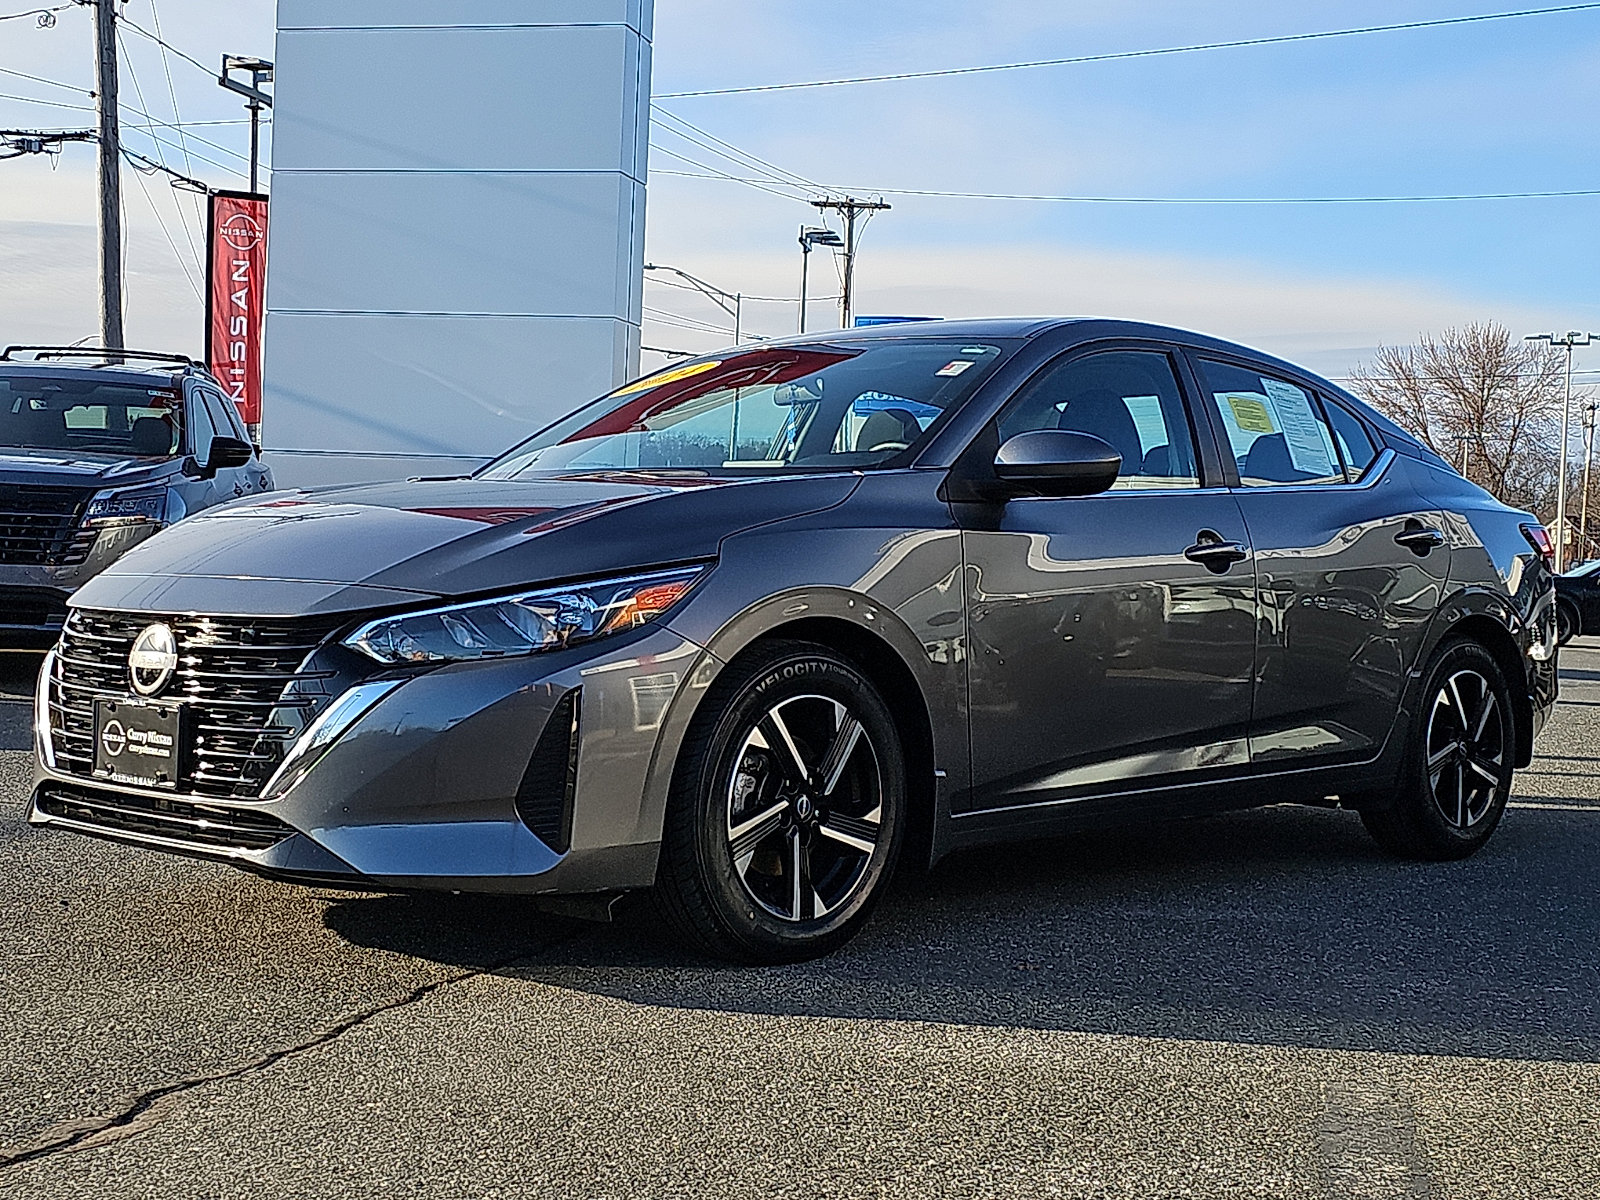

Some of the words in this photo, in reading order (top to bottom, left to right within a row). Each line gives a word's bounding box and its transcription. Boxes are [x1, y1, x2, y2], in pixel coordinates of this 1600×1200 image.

[219, 226, 264, 239] NISSAN
[229, 259, 250, 404] NISSAN
[755, 661, 828, 693] VELOCITY
